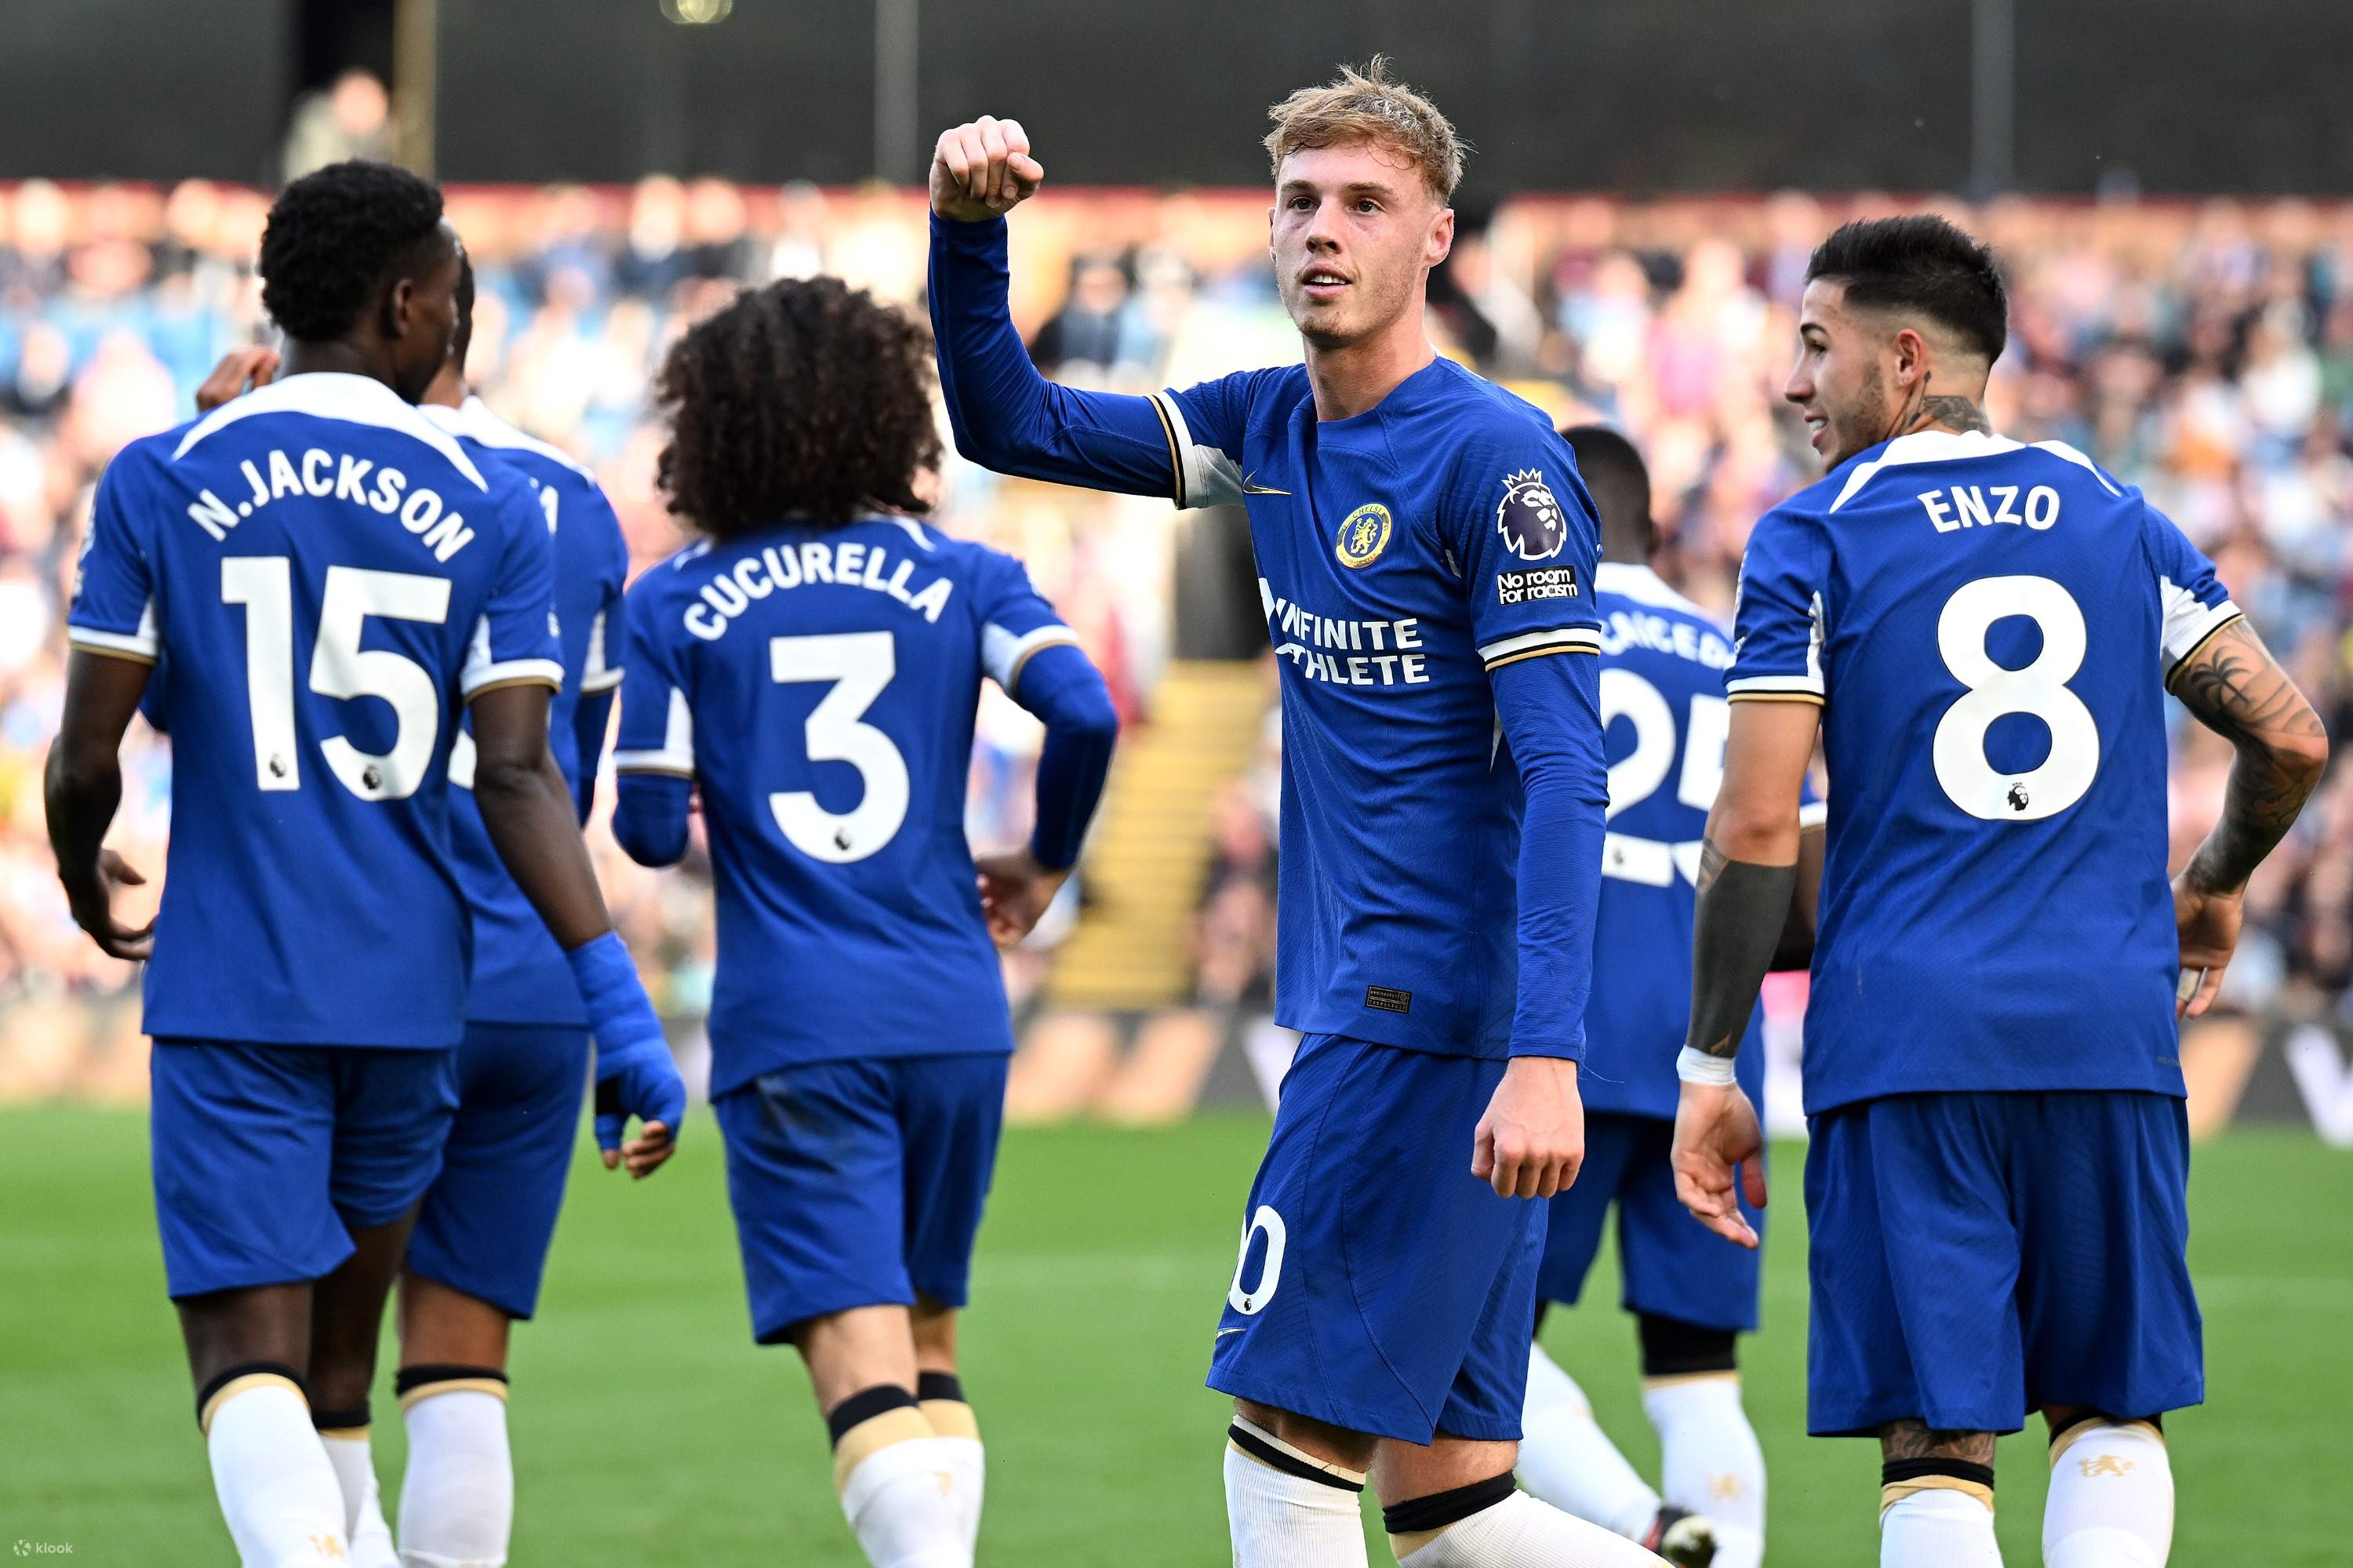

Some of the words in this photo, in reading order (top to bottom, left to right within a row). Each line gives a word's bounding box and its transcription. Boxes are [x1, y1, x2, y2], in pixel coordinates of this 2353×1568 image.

[188, 448, 475, 562] N.JACKSON
[1917, 485, 2060, 533] ENZO
[684, 542, 953, 641] CUCURELLA
[1497, 573, 1524, 589] No
[1526, 569, 1570, 585] room
[1499, 588, 1524, 605] for
[1526, 584, 1578, 600] racism
[220, 556, 452, 802] 15
[1597, 610, 1737, 671] CAICED
[769, 631, 910, 864] 3
[1933, 575, 2100, 820] 8
[1229, 1205, 1286, 1315] 0
